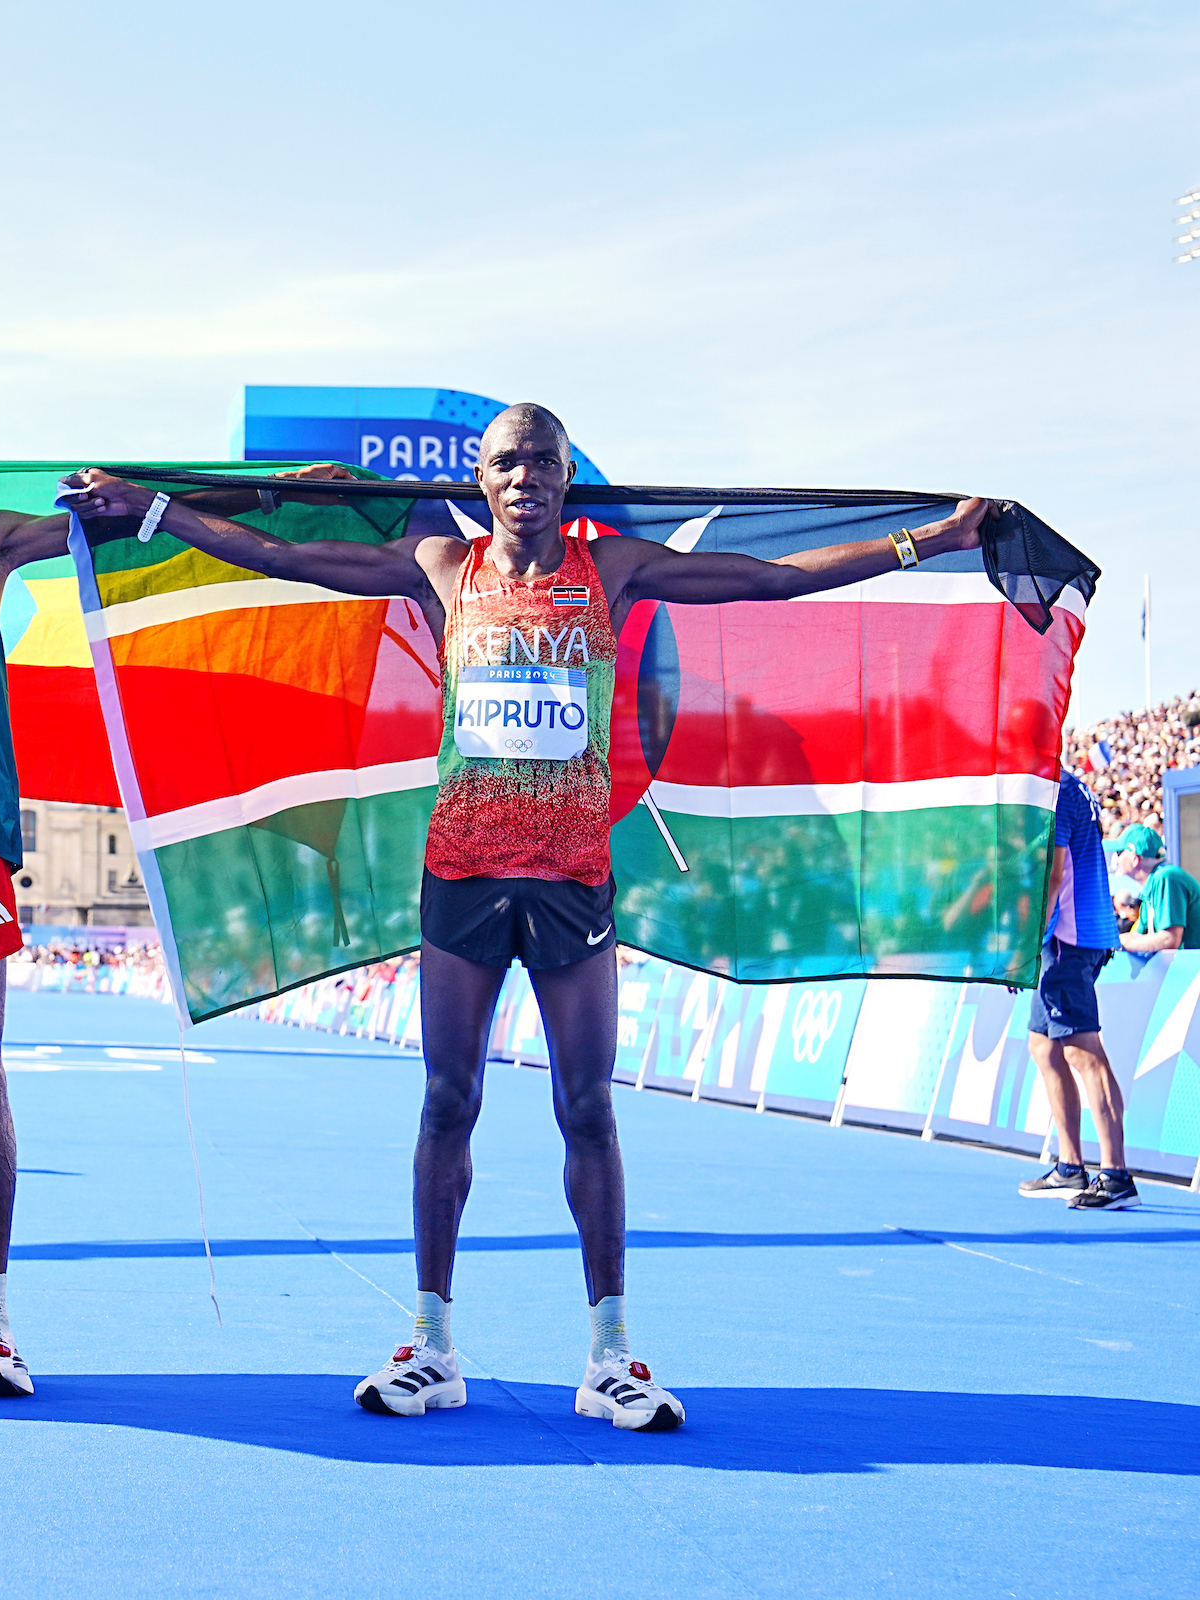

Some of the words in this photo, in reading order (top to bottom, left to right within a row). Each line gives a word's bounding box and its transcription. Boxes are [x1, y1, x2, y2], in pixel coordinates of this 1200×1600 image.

[462, 626, 590, 662] KENYA
[525, 670, 555, 680] 2024
[457, 699, 585, 730] KIPRUTO
